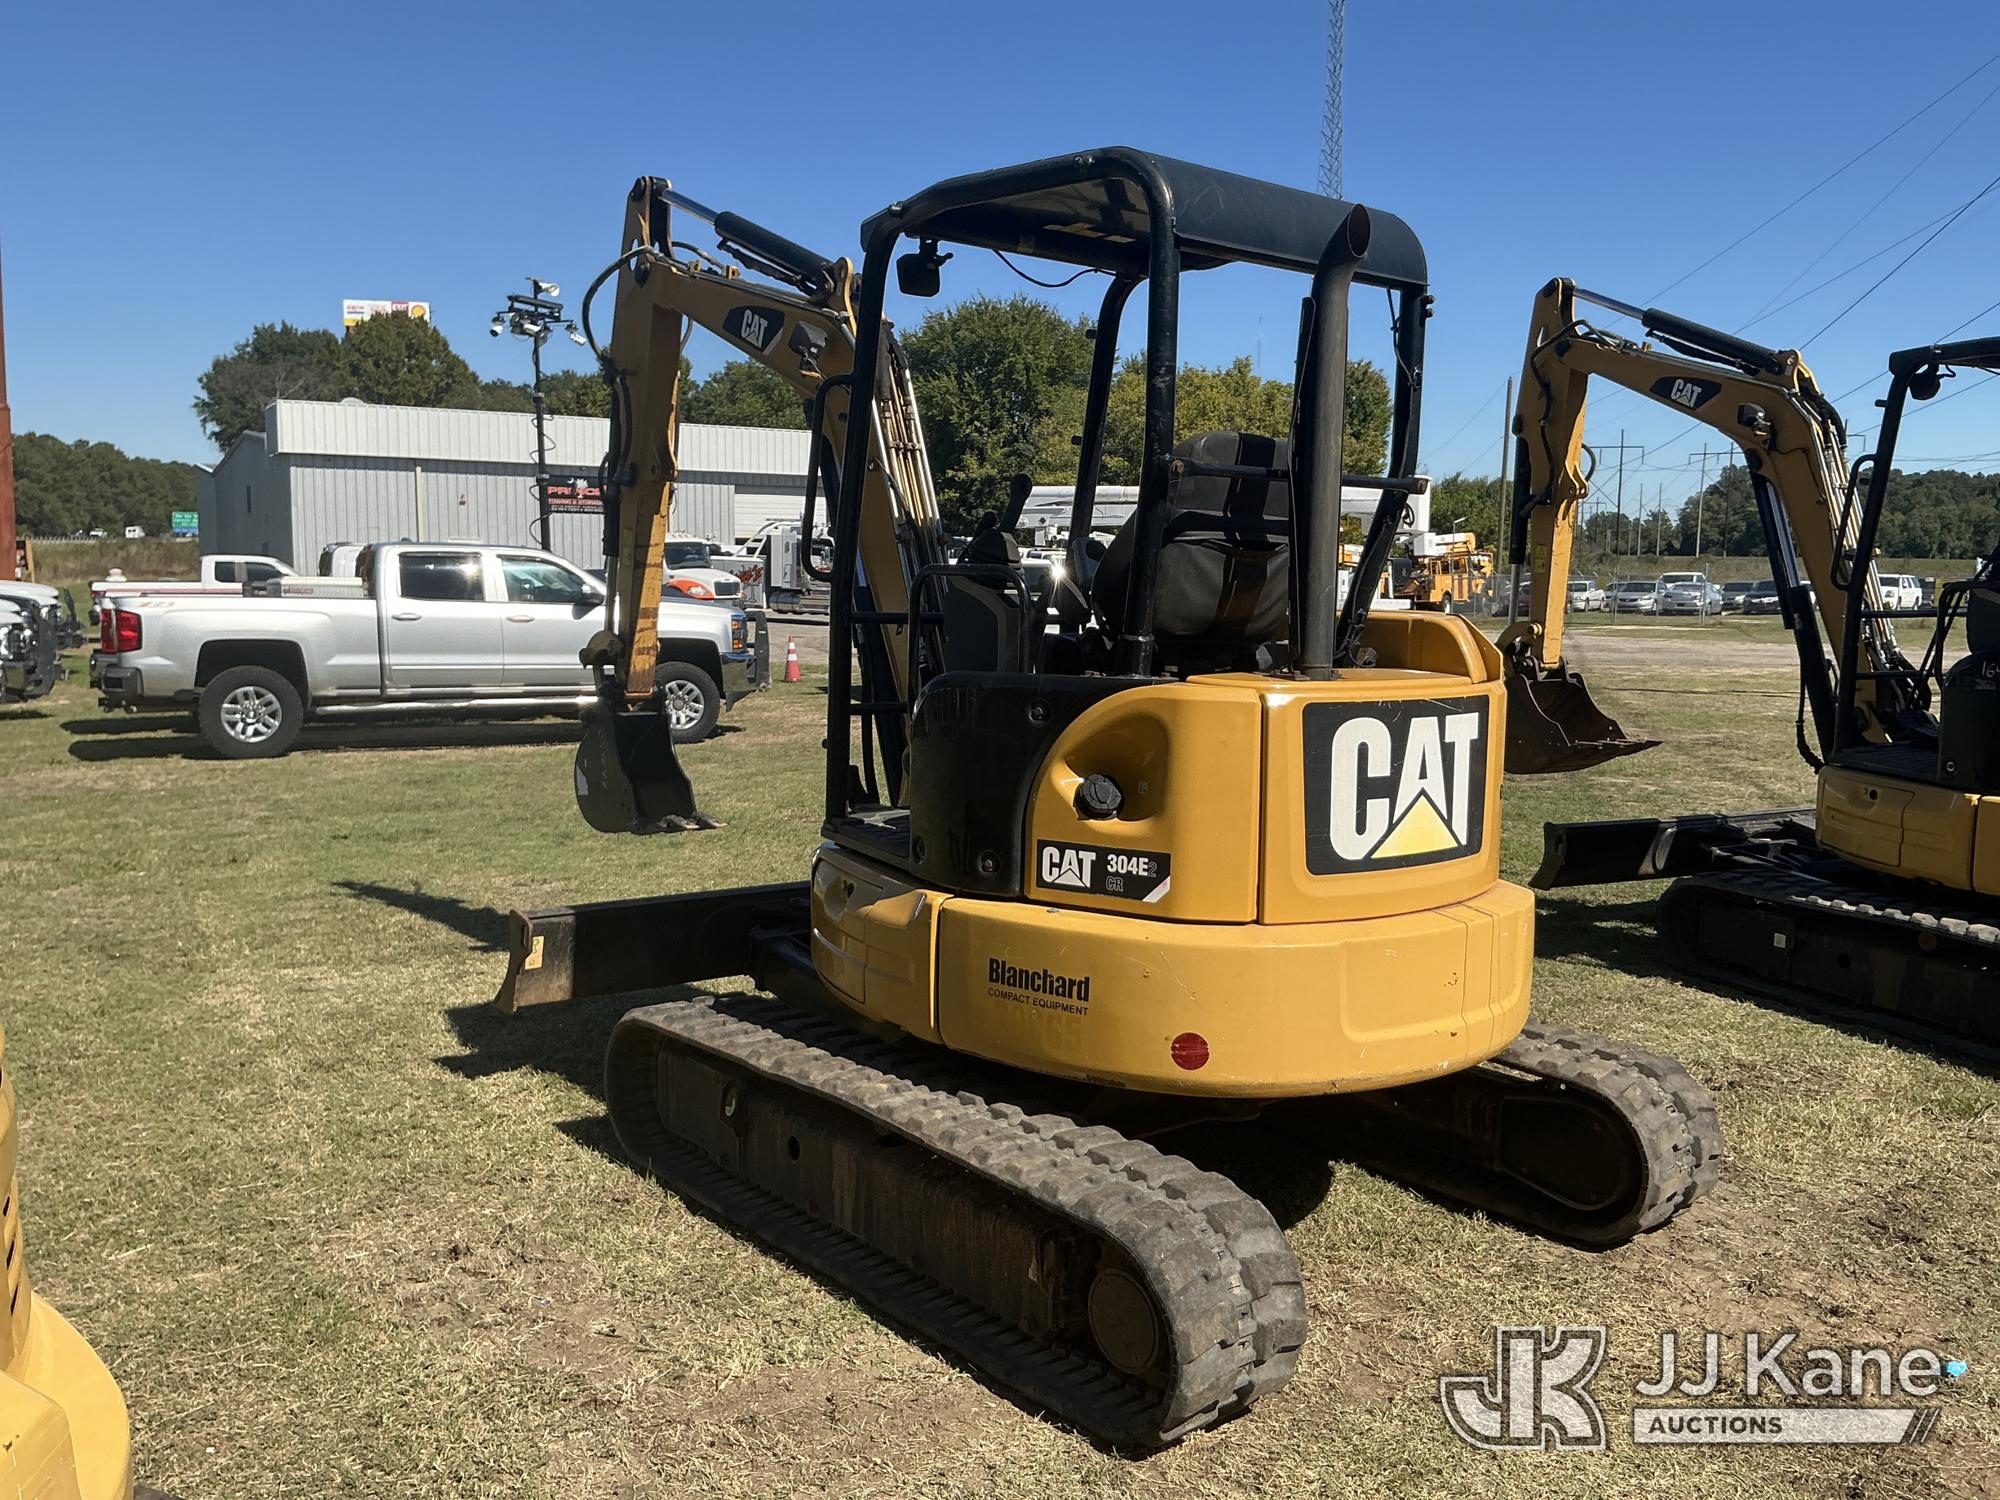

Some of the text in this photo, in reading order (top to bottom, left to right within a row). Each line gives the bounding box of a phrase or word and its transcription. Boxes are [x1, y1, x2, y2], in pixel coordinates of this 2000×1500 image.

[741, 309, 769, 348] CAT
[1670, 378, 1702, 408] CAT
[1330, 712, 1479, 860] CAT
[1042, 846, 1158, 888] CAT 304E2
[1105, 875, 1124, 892] CR
[988, 957, 1091, 1002] Blanchard
[988, 987, 1088, 1015] COMPACT EQUIPMENT
